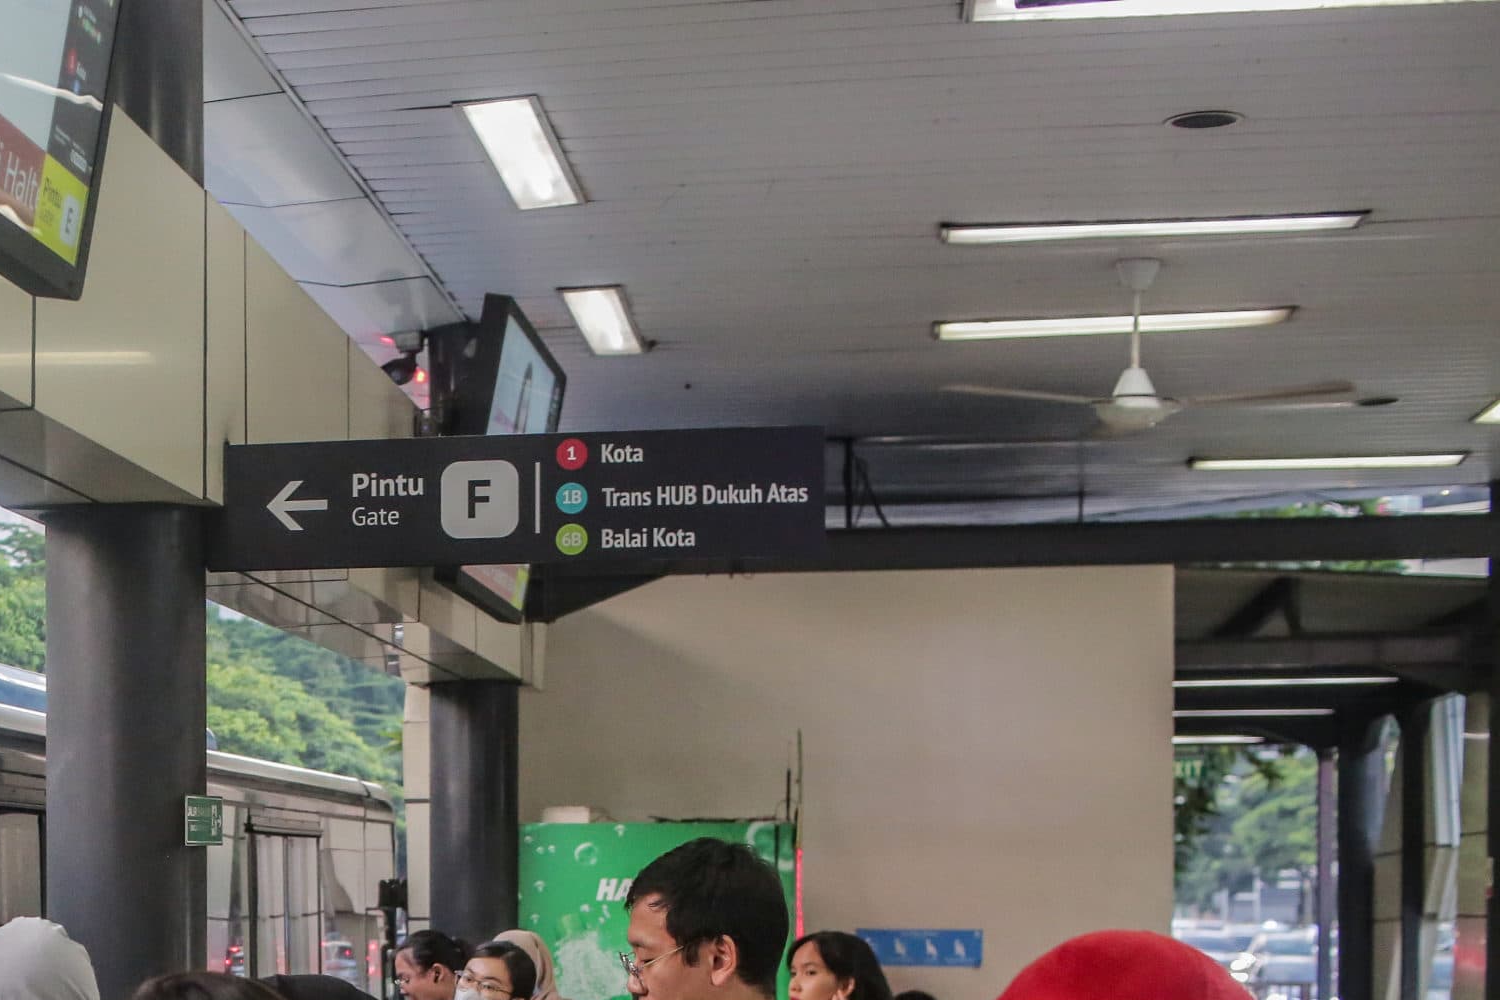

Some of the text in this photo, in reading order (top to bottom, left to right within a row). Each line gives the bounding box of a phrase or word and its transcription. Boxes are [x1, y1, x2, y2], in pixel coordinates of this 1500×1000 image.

[3, 151, 40, 213] Halt
[566, 443, 644, 463] 1 Kota
[351, 473, 424, 497] Pintu
[562, 482, 809, 507] 1B Trans HUB Dukuh Atas
[467, 479, 491, 519] F
[351, 506, 400, 527] Gate
[561, 527, 696, 549] 6B Balai Kota
[596, 878, 634, 902] HA
